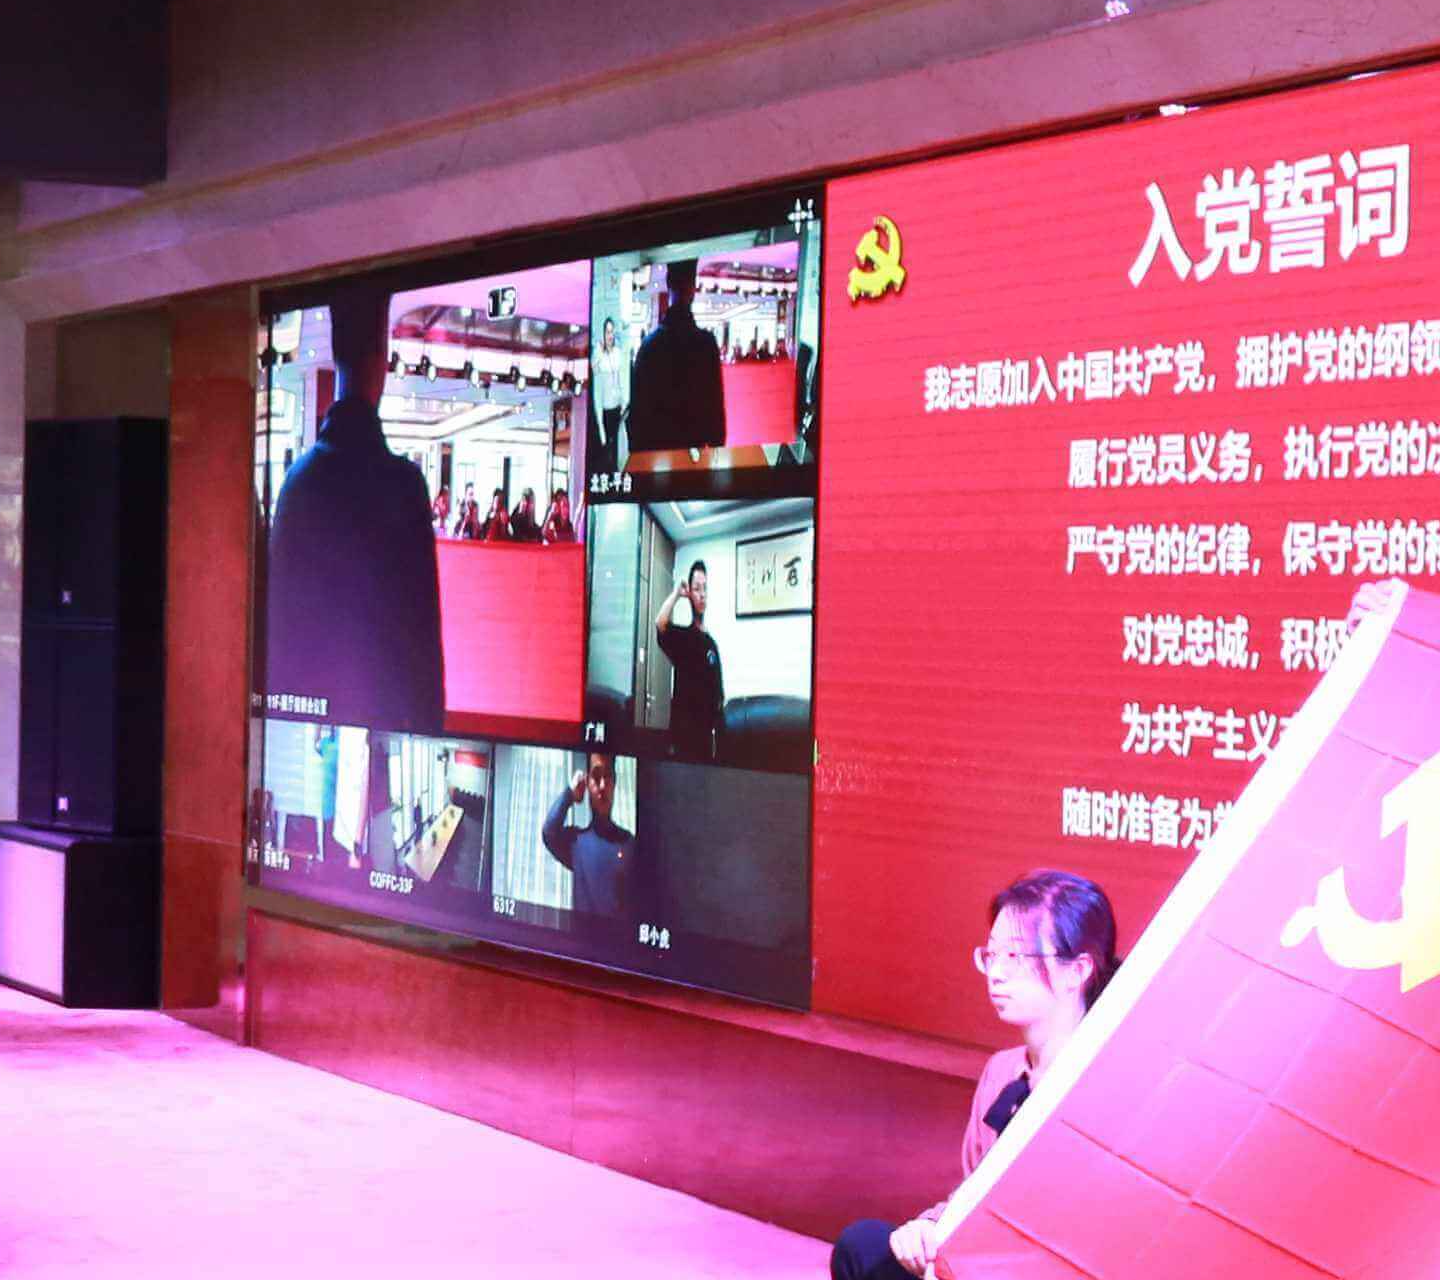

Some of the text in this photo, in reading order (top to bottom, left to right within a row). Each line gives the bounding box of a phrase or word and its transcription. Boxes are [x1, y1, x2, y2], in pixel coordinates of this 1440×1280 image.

[1127, 144, 1410, 288] 入党誓词
[1121, 702, 1294, 761] 为共产主义
[493, 896, 516, 917] 6312
